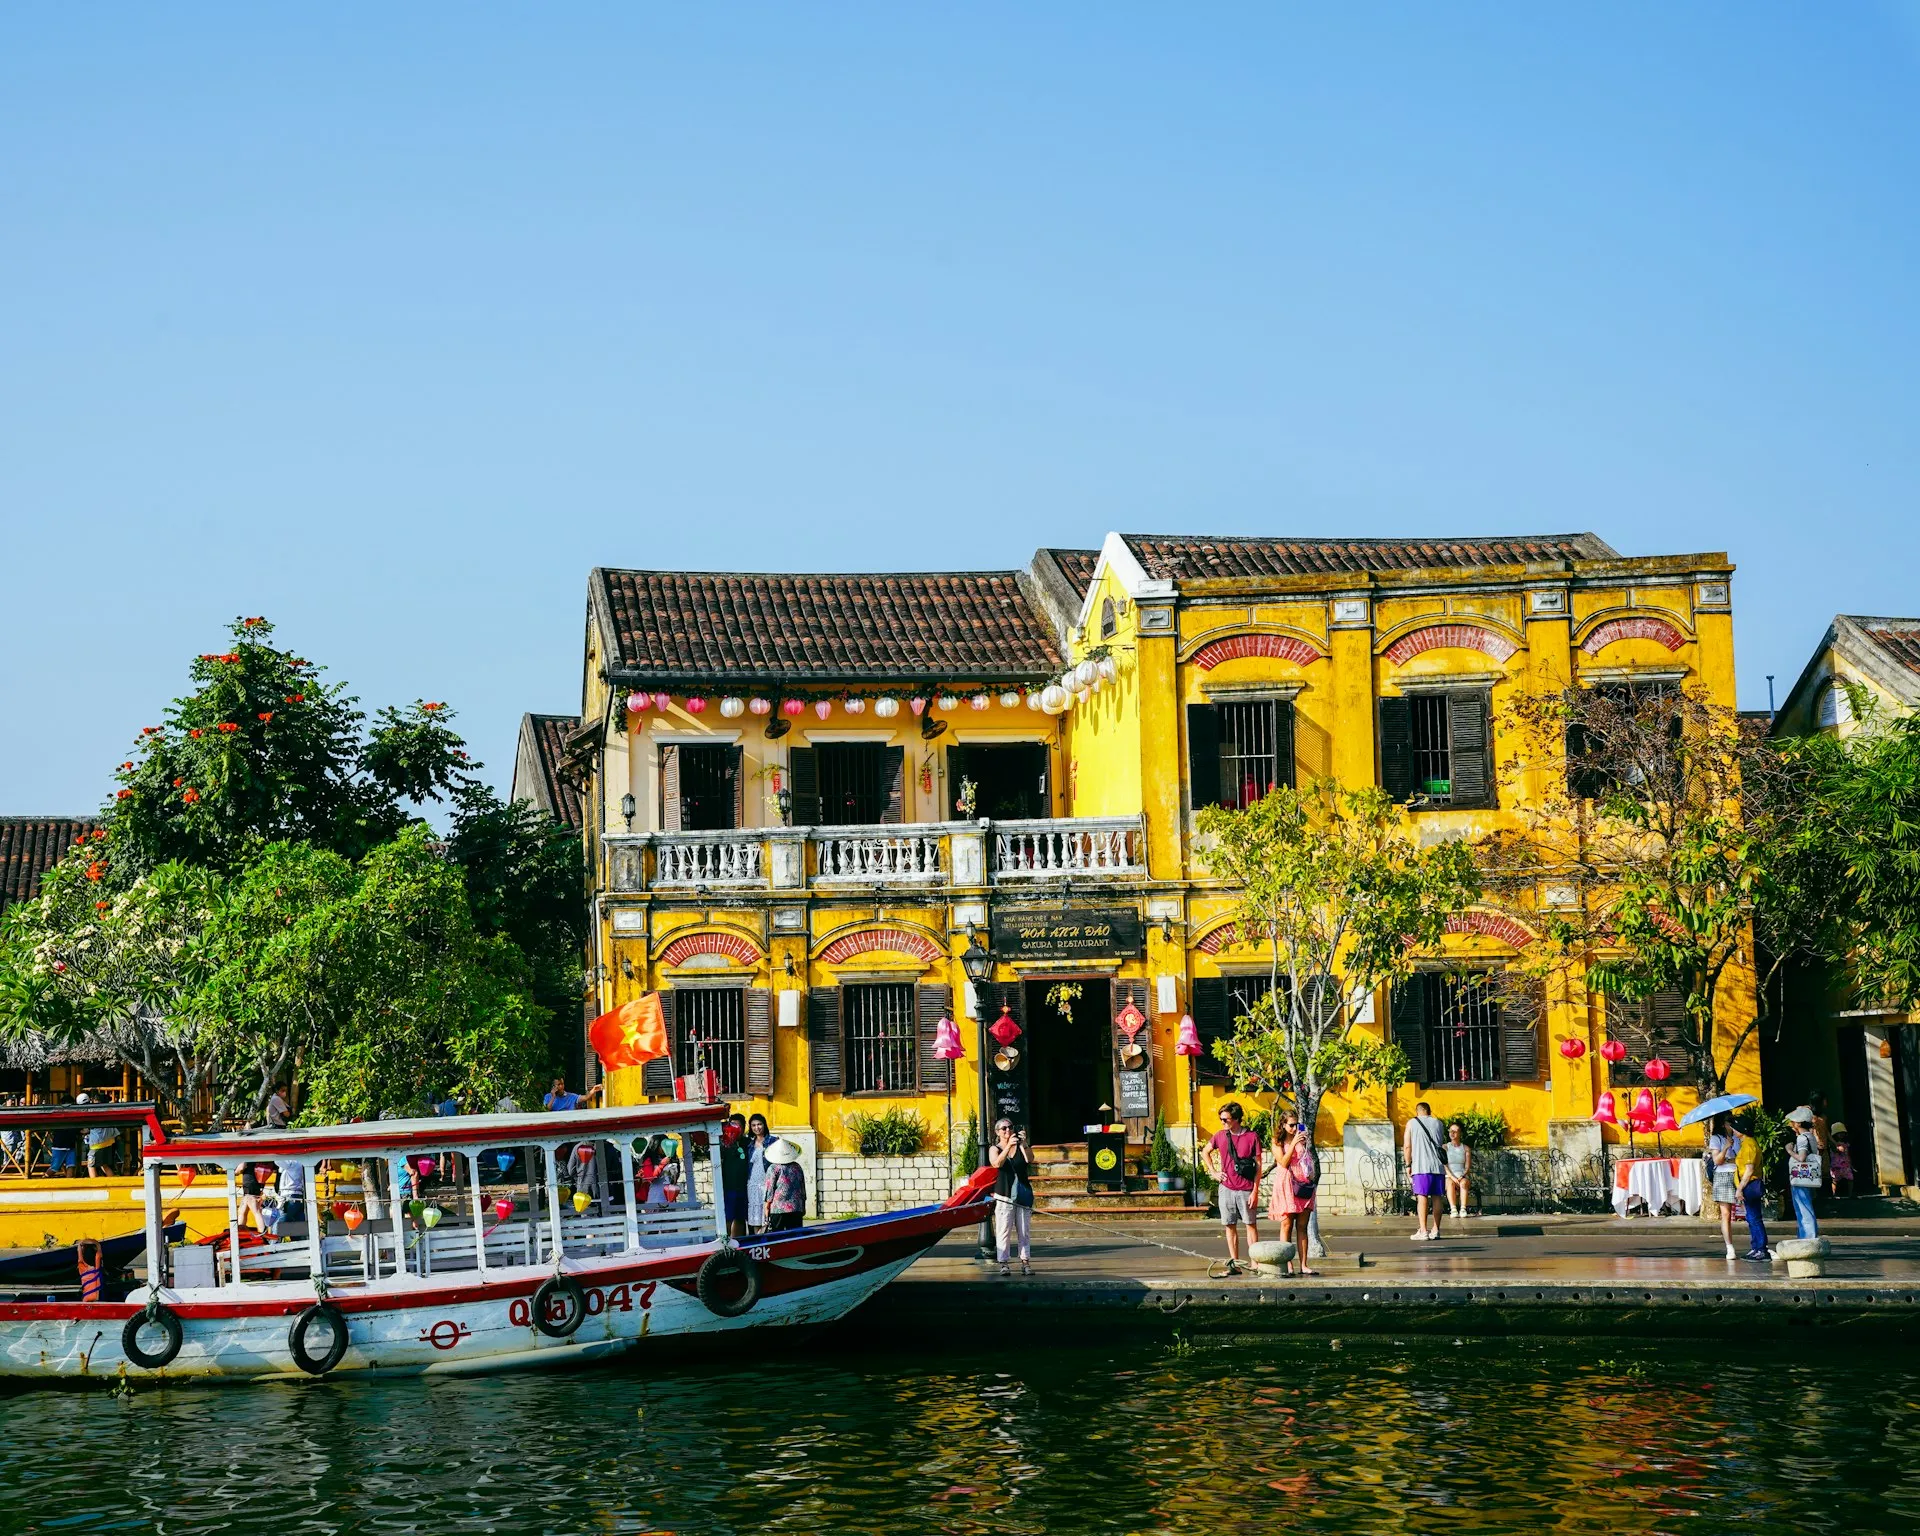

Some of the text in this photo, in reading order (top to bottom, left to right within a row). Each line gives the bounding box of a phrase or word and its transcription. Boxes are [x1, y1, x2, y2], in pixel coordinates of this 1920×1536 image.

[1019, 927, 1046, 938] HOA
[1049, 926, 1079, 937] ANH
[1021, 939, 1110, 949] SAKURA RESTAURANT
[460, 1322, 467, 1330] R
